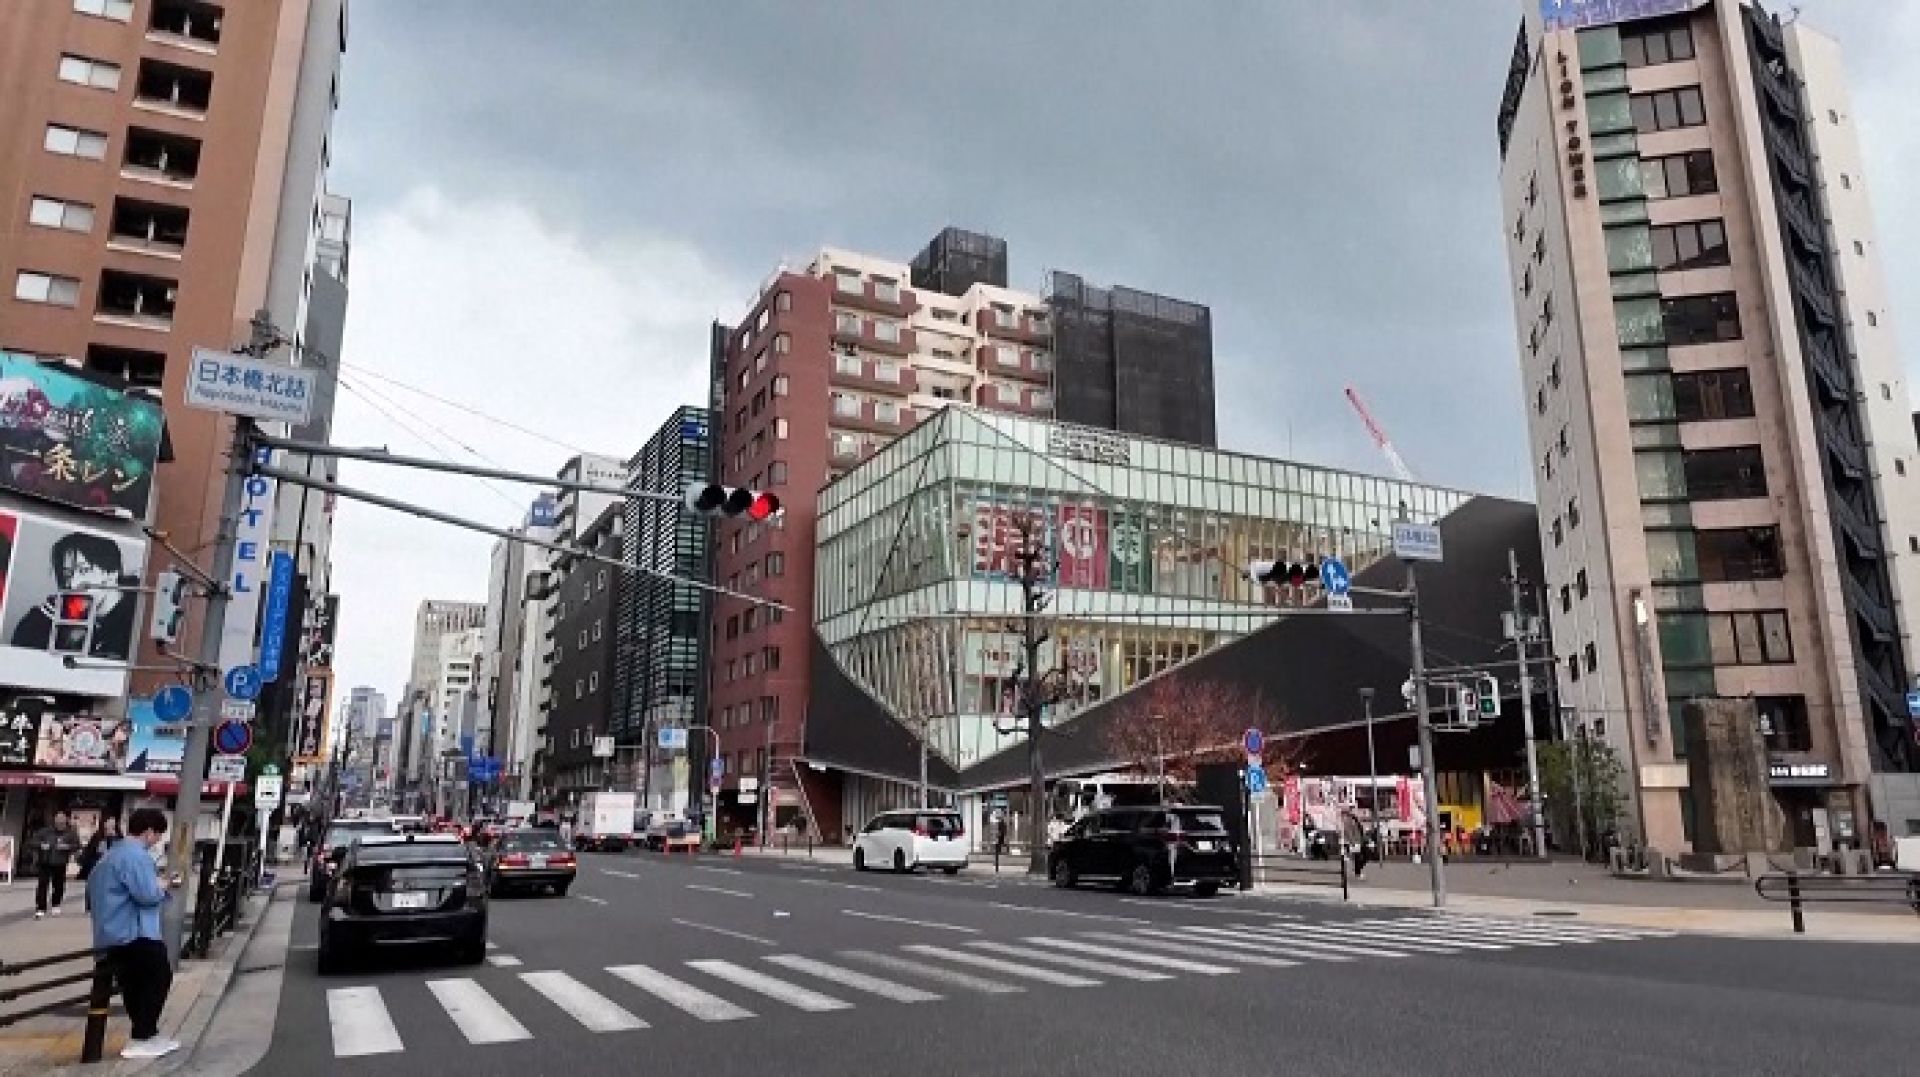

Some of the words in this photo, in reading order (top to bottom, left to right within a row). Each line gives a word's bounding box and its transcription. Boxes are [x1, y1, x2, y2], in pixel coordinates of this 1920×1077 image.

[1557, 50, 1576, 111] LION
[1565, 119, 1588, 199] TOWER
[199, 360, 305, 398] 日本橋北詰
[235, 444, 271, 593] HOTEL
[232, 673, 248, 694] P
